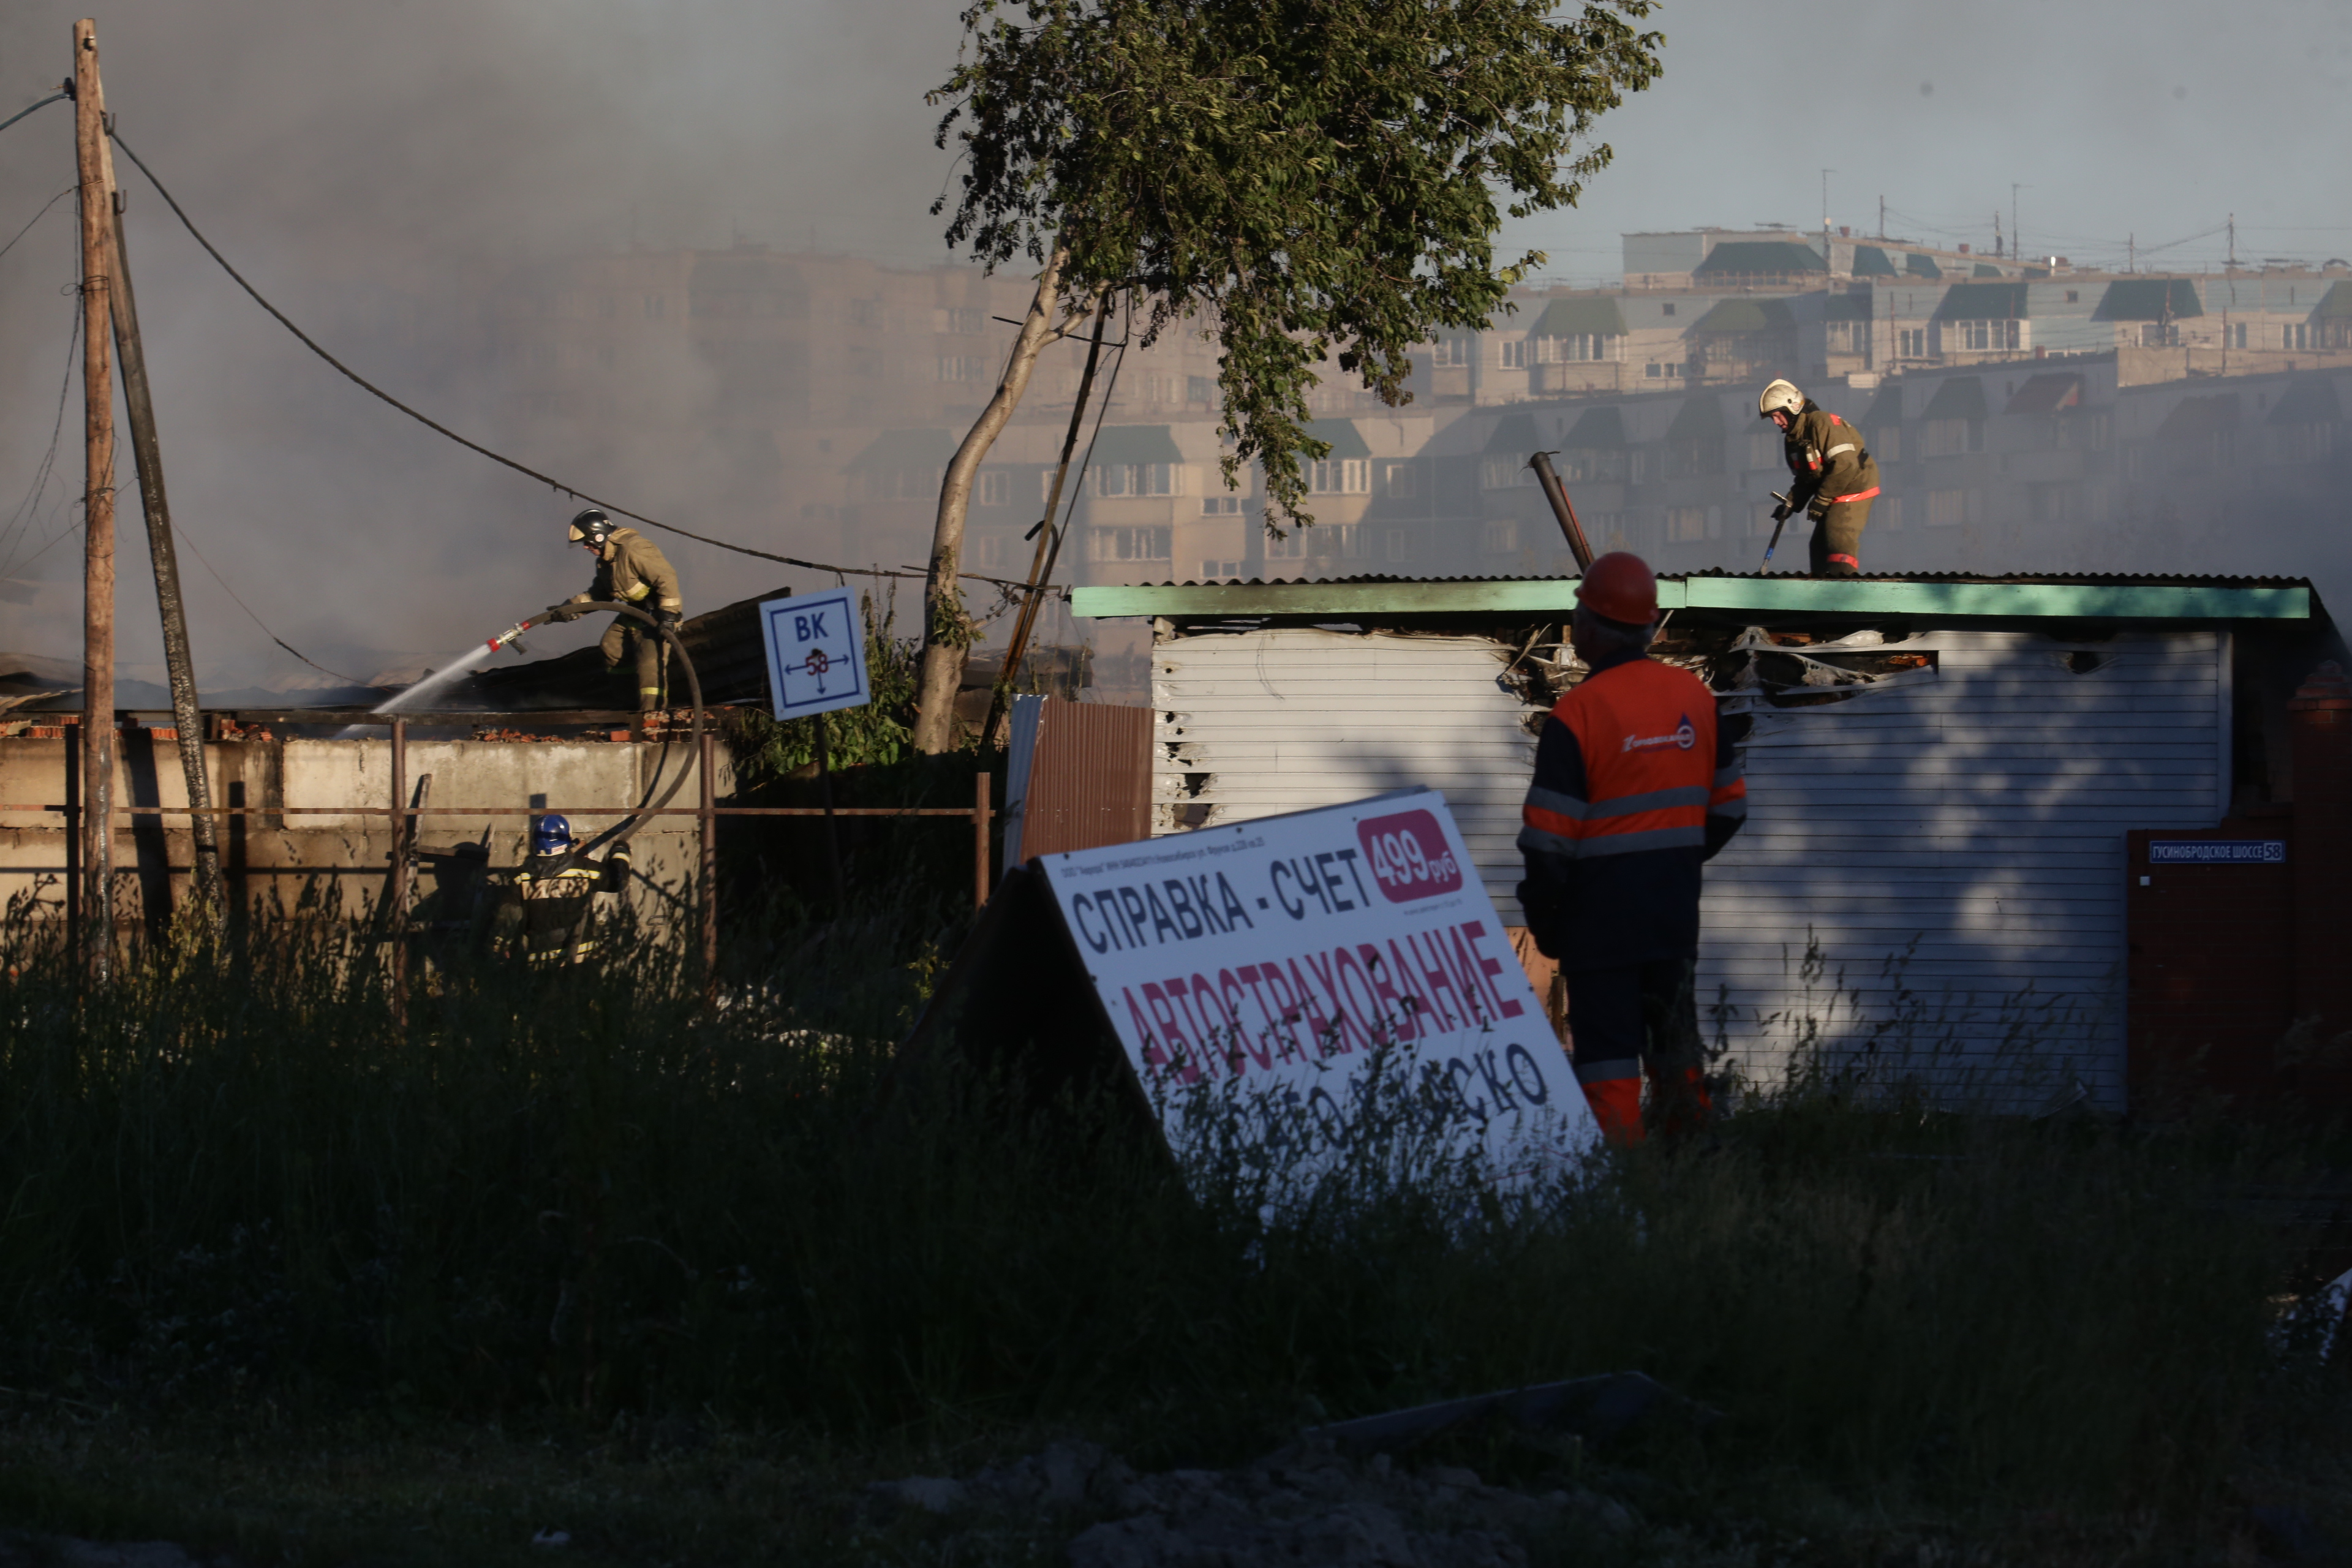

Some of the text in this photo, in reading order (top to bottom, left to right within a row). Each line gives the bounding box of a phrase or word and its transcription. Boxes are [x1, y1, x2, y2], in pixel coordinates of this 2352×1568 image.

[794, 612, 829, 643] ВК
[805, 654, 829, 676] 58
[1371, 829, 1457, 887] 499 руб
[2152, 844, 2282, 861] ГУСИНОБРОДСКОЕ ШОССЕ 58
[1072, 872, 1254, 954] СПРАВКА
[1270, 848, 1371, 920] СЧЕТ
[1121, 920, 1525, 1088] АВТОСТРАХОВАНИЕ
